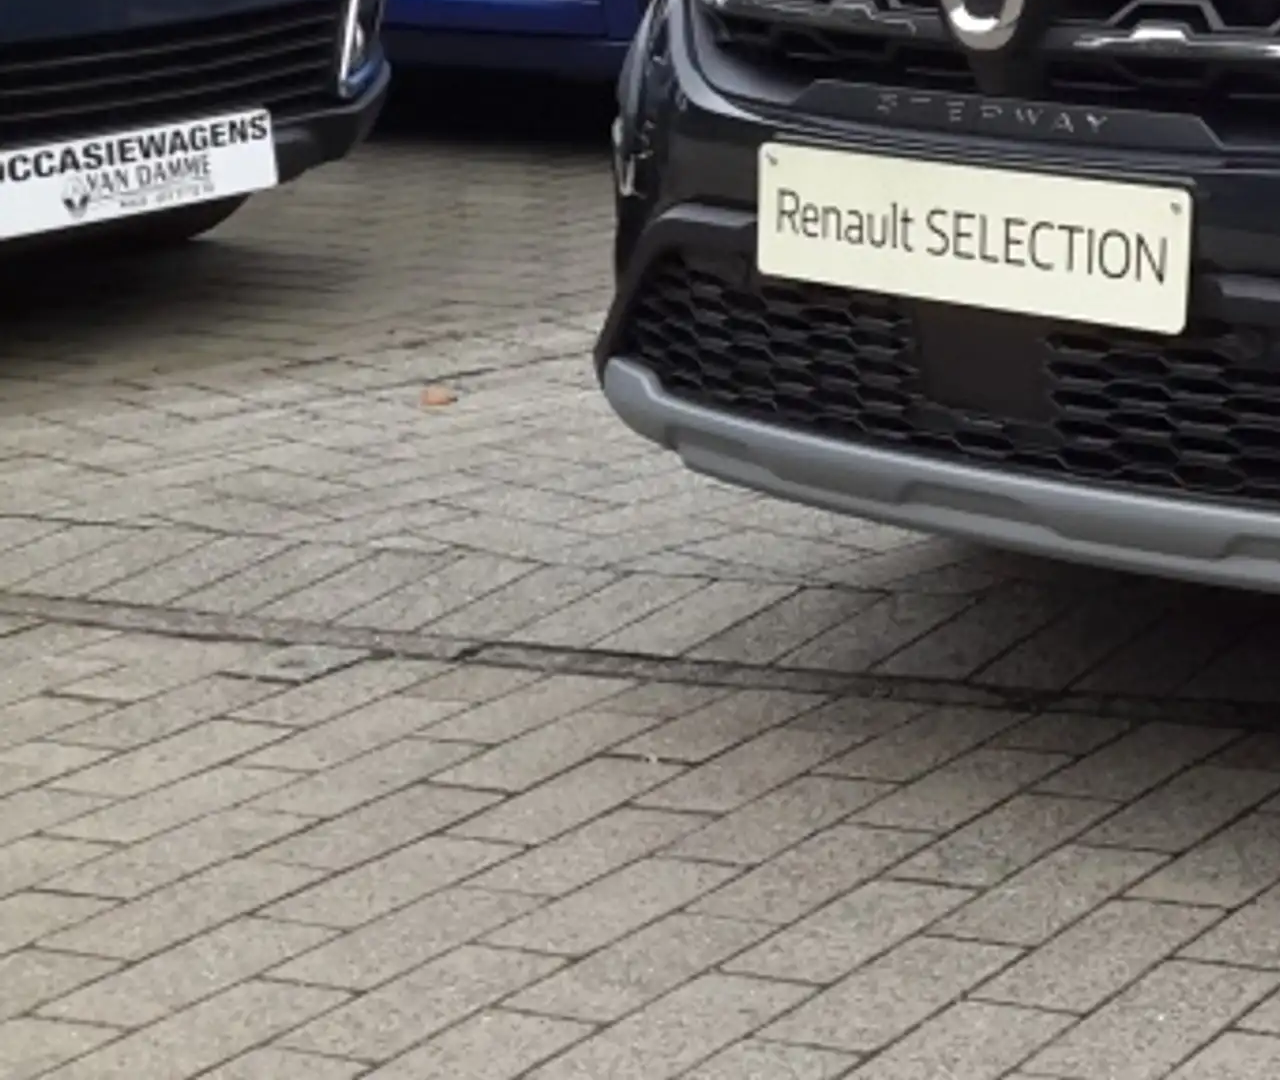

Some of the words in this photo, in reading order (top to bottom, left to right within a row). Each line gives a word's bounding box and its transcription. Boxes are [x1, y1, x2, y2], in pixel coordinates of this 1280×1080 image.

[877, 93, 1109, 133] STEPWAY
[0, 114, 268, 183] CCASIEWAGENS
[86, 169, 130, 193] VAN
[136, 154, 212, 187] DAMME
[776, 188, 914, 253] Renault
[926, 209, 1168, 286] SELECTION
